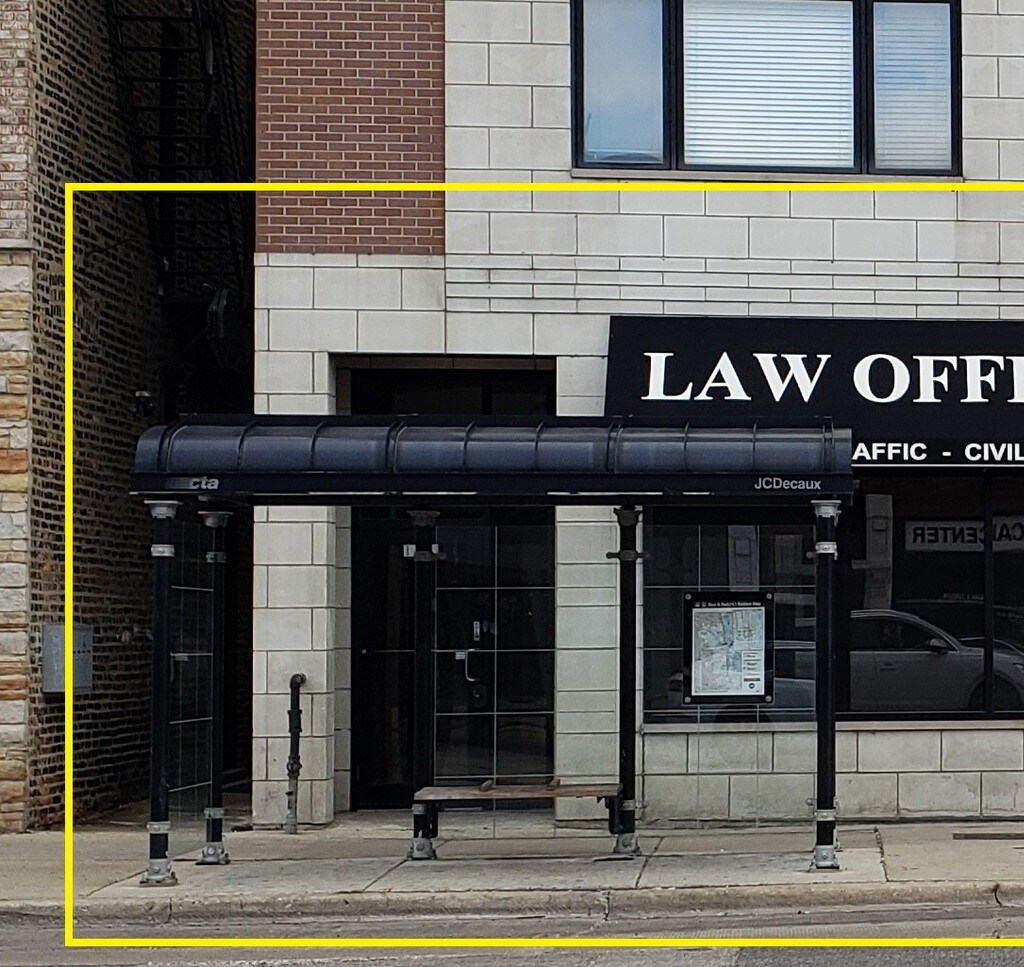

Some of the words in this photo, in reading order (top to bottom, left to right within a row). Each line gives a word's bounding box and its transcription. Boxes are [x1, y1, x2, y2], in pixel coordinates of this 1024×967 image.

[641, 351, 832, 403] LAW
[199, 476, 219, 490] cta
[754, 477, 822, 490] JCDecaux
